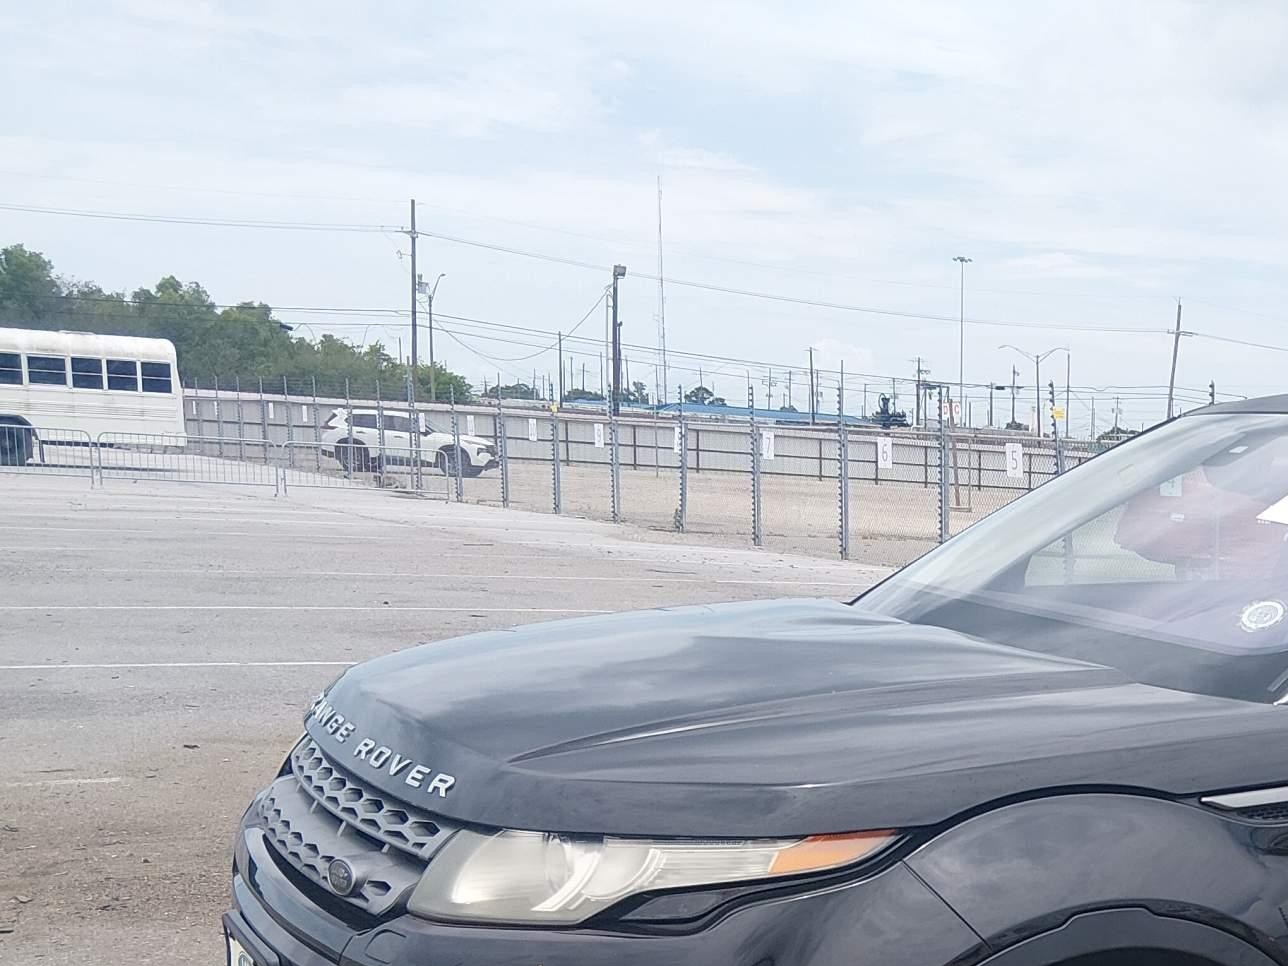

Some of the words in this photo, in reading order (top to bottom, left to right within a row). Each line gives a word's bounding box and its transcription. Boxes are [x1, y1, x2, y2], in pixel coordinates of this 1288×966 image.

[881, 443, 889, 462] 6
[1011, 450, 1019, 470] 5
[353, 737, 456, 798] ROVER
